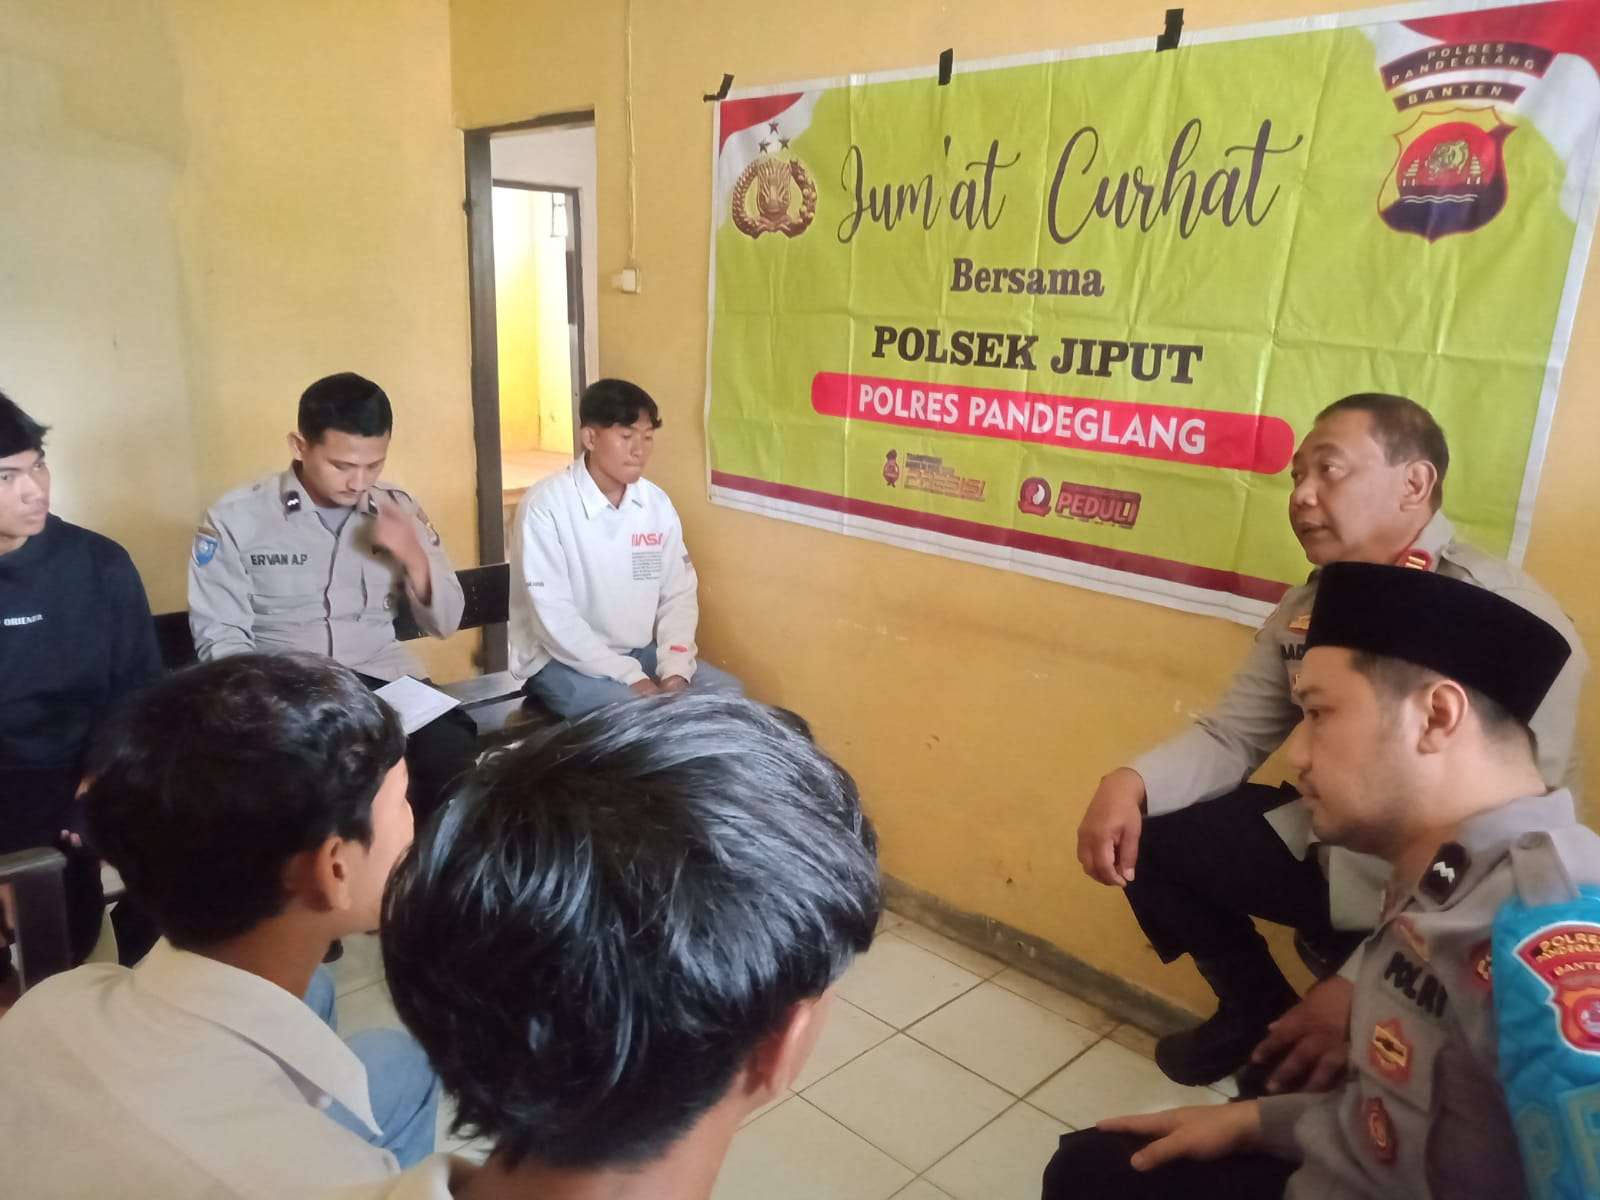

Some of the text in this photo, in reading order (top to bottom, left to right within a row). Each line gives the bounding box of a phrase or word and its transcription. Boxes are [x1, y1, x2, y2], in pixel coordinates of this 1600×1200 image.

[1427, 43, 1505, 60] POLRES
[1391, 54, 1536, 85] PANDEGLANG
[1408, 84, 1503, 104] BANTEN
[837, 118, 1303, 245] Jum'at Curhat
[950, 257, 1105, 297] Bersama
[871, 325, 1204, 384] POLSEK JIPUT
[858, 384, 1206, 455] POLRES PANDEGLANG
[1056, 491, 1138, 523] PEDULI
[250, 554, 289, 566] ERVAN
[1539, 932, 1600, 952] POLRE
[1553, 961, 1600, 977] BANTE
